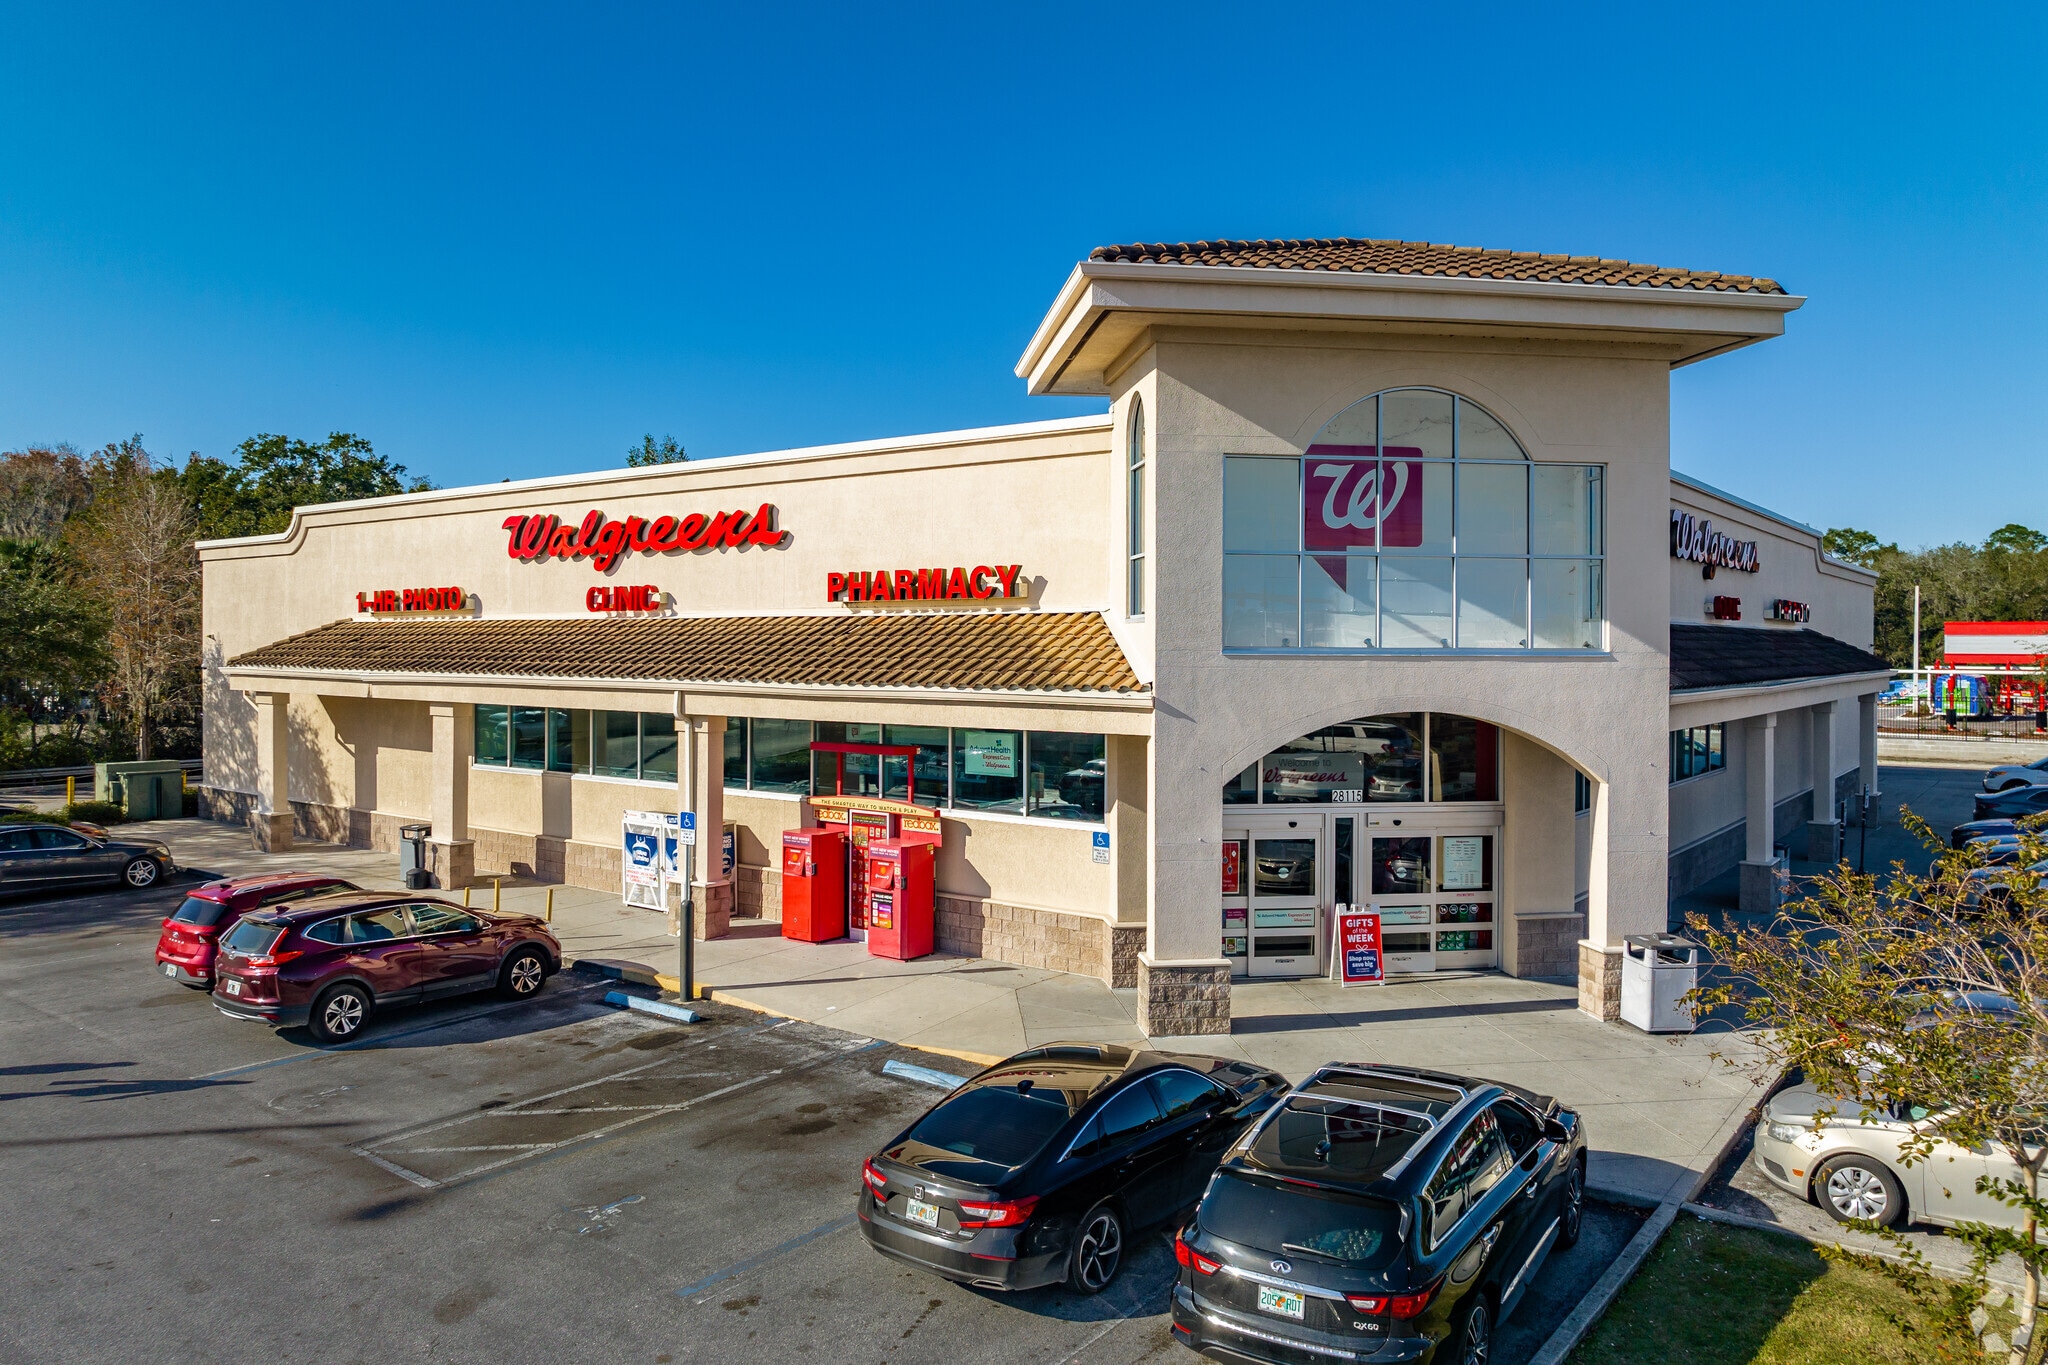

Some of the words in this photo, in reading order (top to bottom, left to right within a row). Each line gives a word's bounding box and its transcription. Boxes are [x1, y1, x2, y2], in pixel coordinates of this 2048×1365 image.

[502, 503, 786, 572] Walgreens
[827, 564, 1023, 603] PHARMACY
[355, 590, 396, 613] 1-HR
[402, 586, 462, 611] PHOTO
[586, 584, 660, 612] CLINIC
[1279, 758, 1320, 767] Welcome
[1322, 759, 1332, 767] to
[1332, 790, 1362, 802] 28115
[1346, 918, 1374, 928] GIFTS
[1347, 933, 1374, 943] WEEK
[1353, 1321, 1380, 1331] QX60
